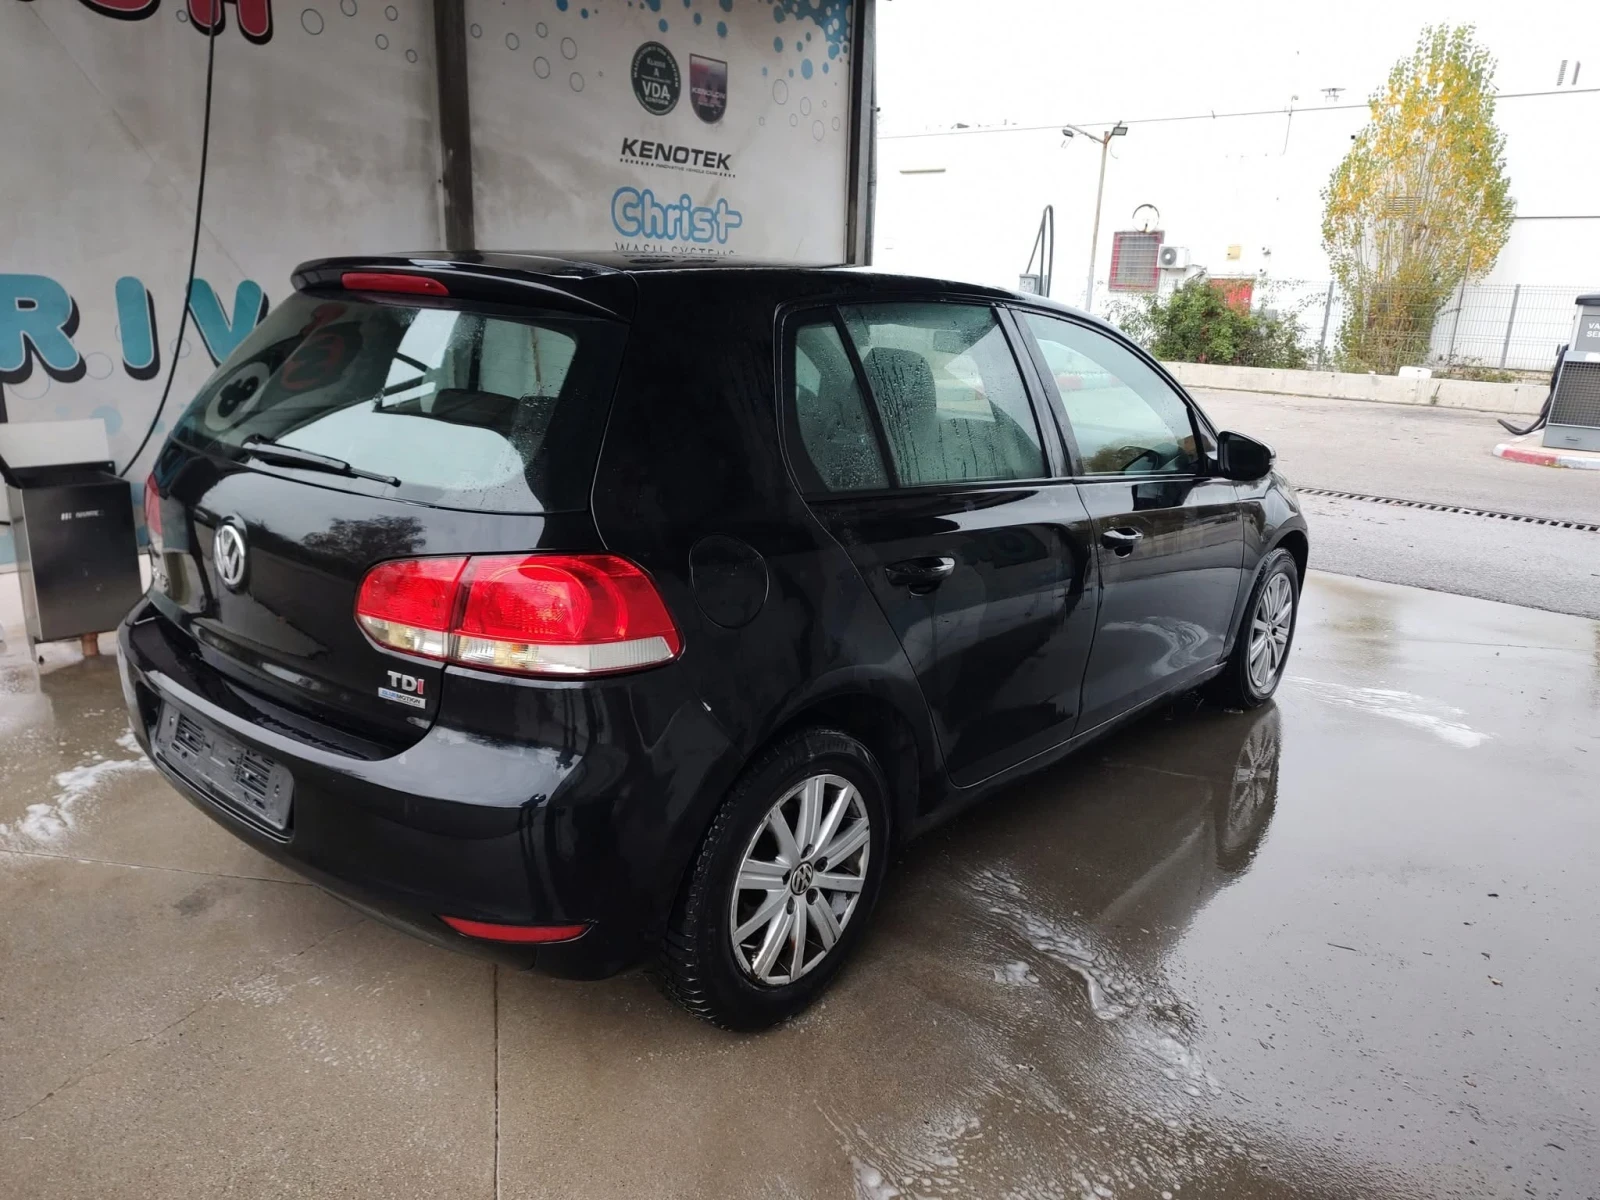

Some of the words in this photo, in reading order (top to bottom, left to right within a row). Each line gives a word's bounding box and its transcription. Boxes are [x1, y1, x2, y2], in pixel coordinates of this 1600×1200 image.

[642, 80, 671, 100] VDA
[621, 137, 732, 171] KENOTEK
[611, 186, 743, 245] Christ
[387, 670, 425, 695] TDI
